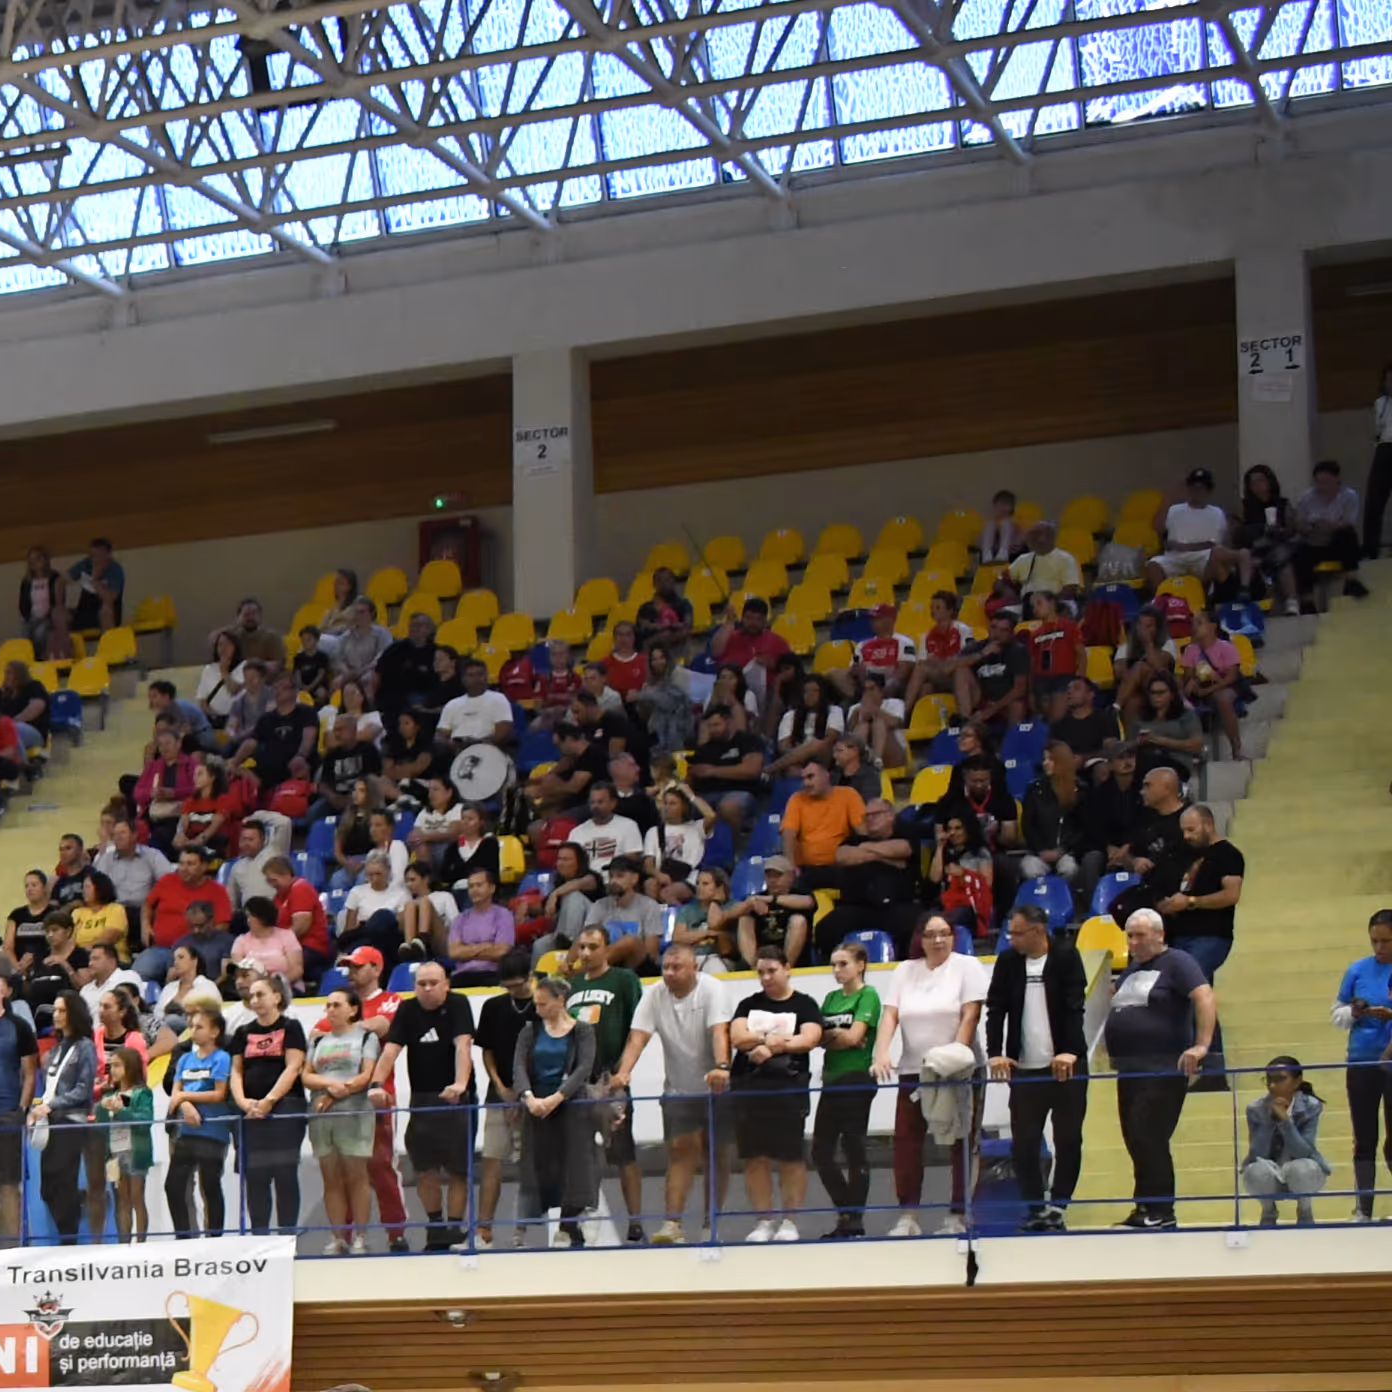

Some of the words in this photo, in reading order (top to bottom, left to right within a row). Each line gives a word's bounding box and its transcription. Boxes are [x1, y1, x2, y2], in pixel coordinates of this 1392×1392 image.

[1240, 335, 1302, 353] SECTOR
[1250, 353, 1260, 367] 2
[1286, 348, 1293, 362] 1
[516, 427, 568, 442] SECTOR
[537, 444, 547, 459] 2
[7, 1259, 164, 1286] Transilvania
[174, 1257, 268, 1277] Brasov
[59, 1333, 80, 1350] de
